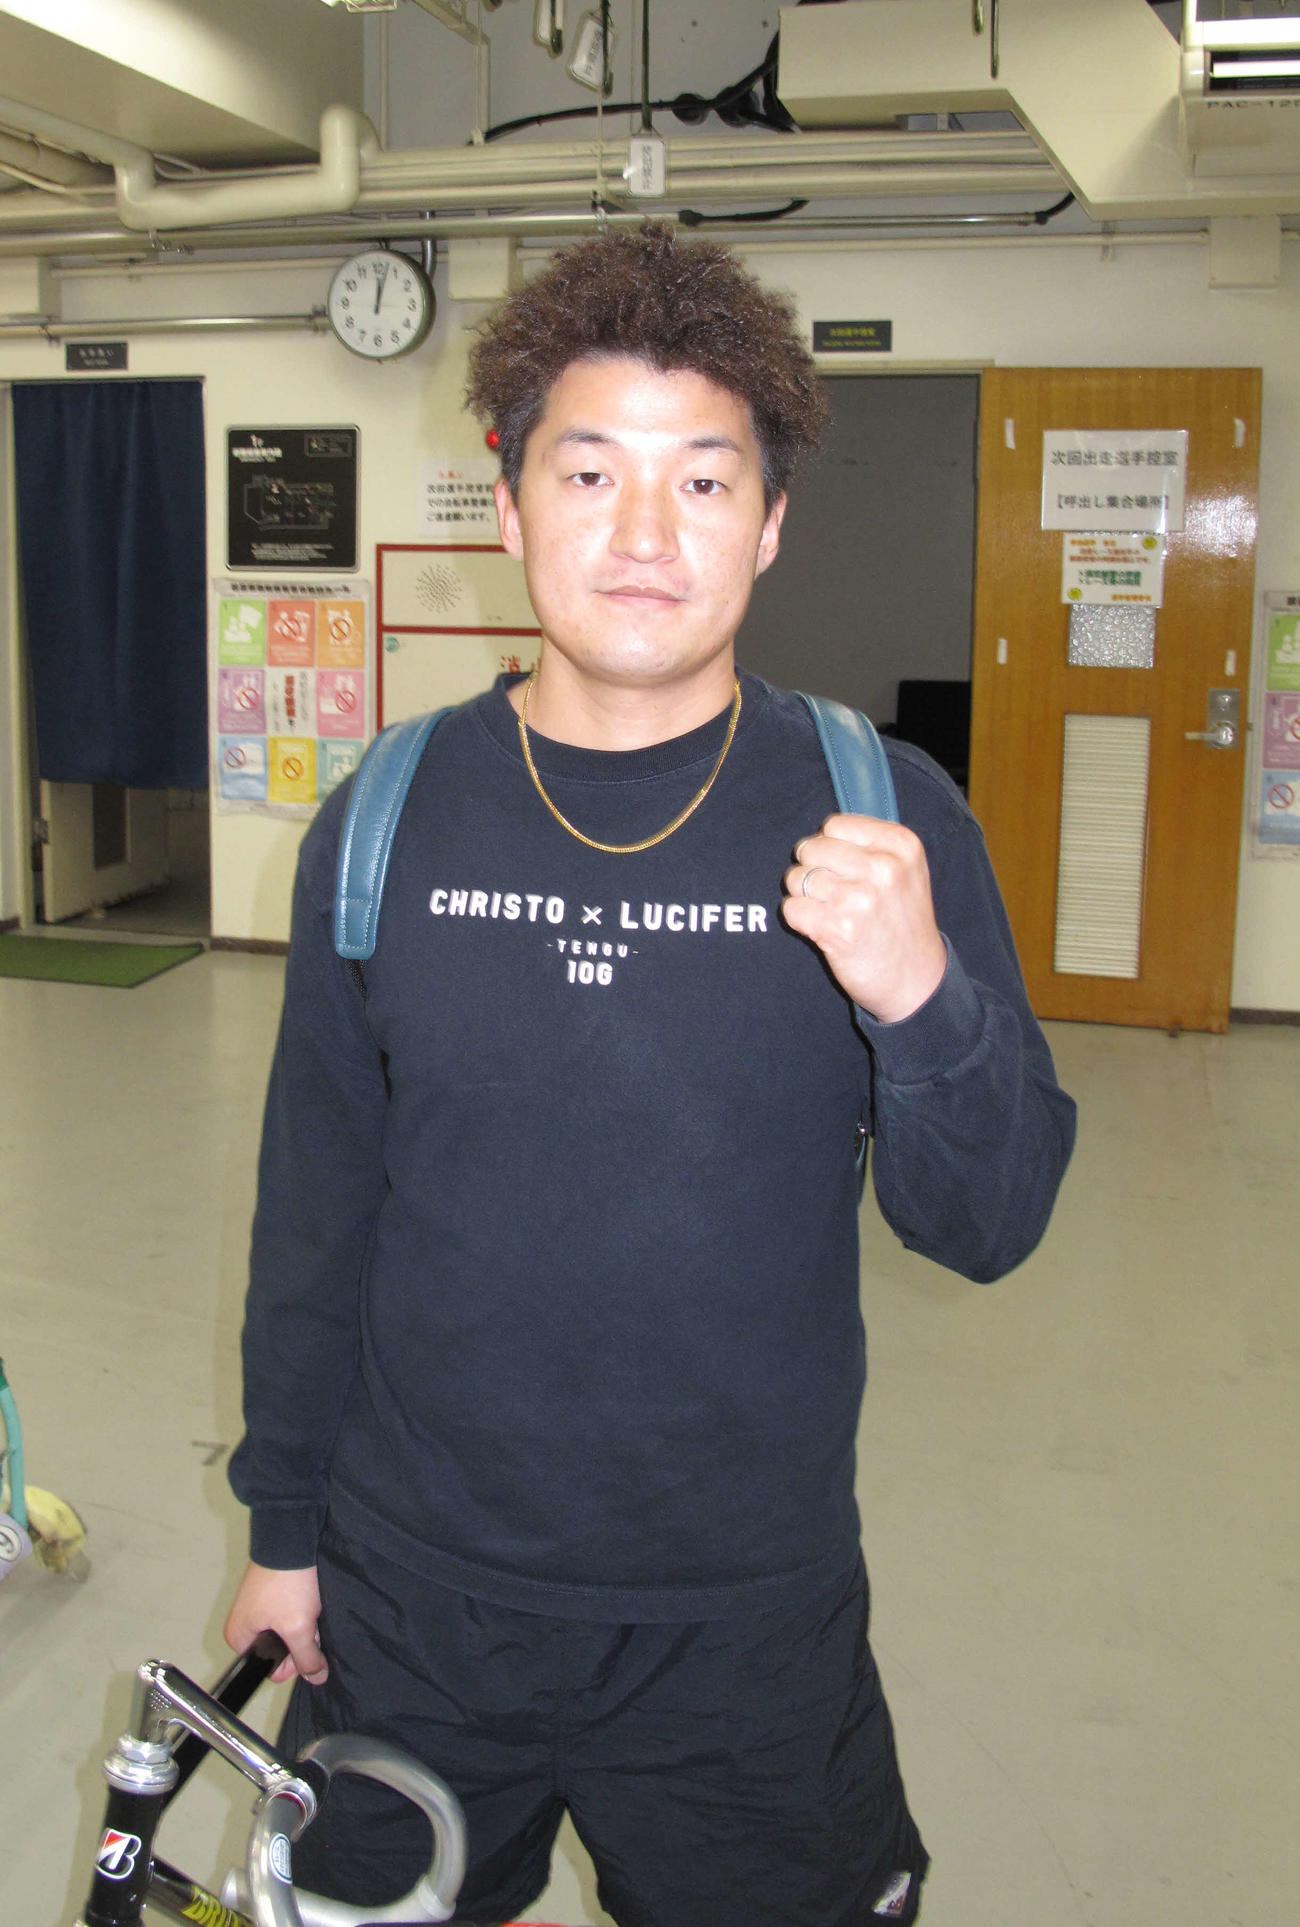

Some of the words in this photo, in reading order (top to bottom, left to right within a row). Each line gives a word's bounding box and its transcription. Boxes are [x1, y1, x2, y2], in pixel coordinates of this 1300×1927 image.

[429, 888, 565, 924] CHRISTO
[620, 900, 768, 932] LUCIFER
[567, 959, 613, 986] 10G
